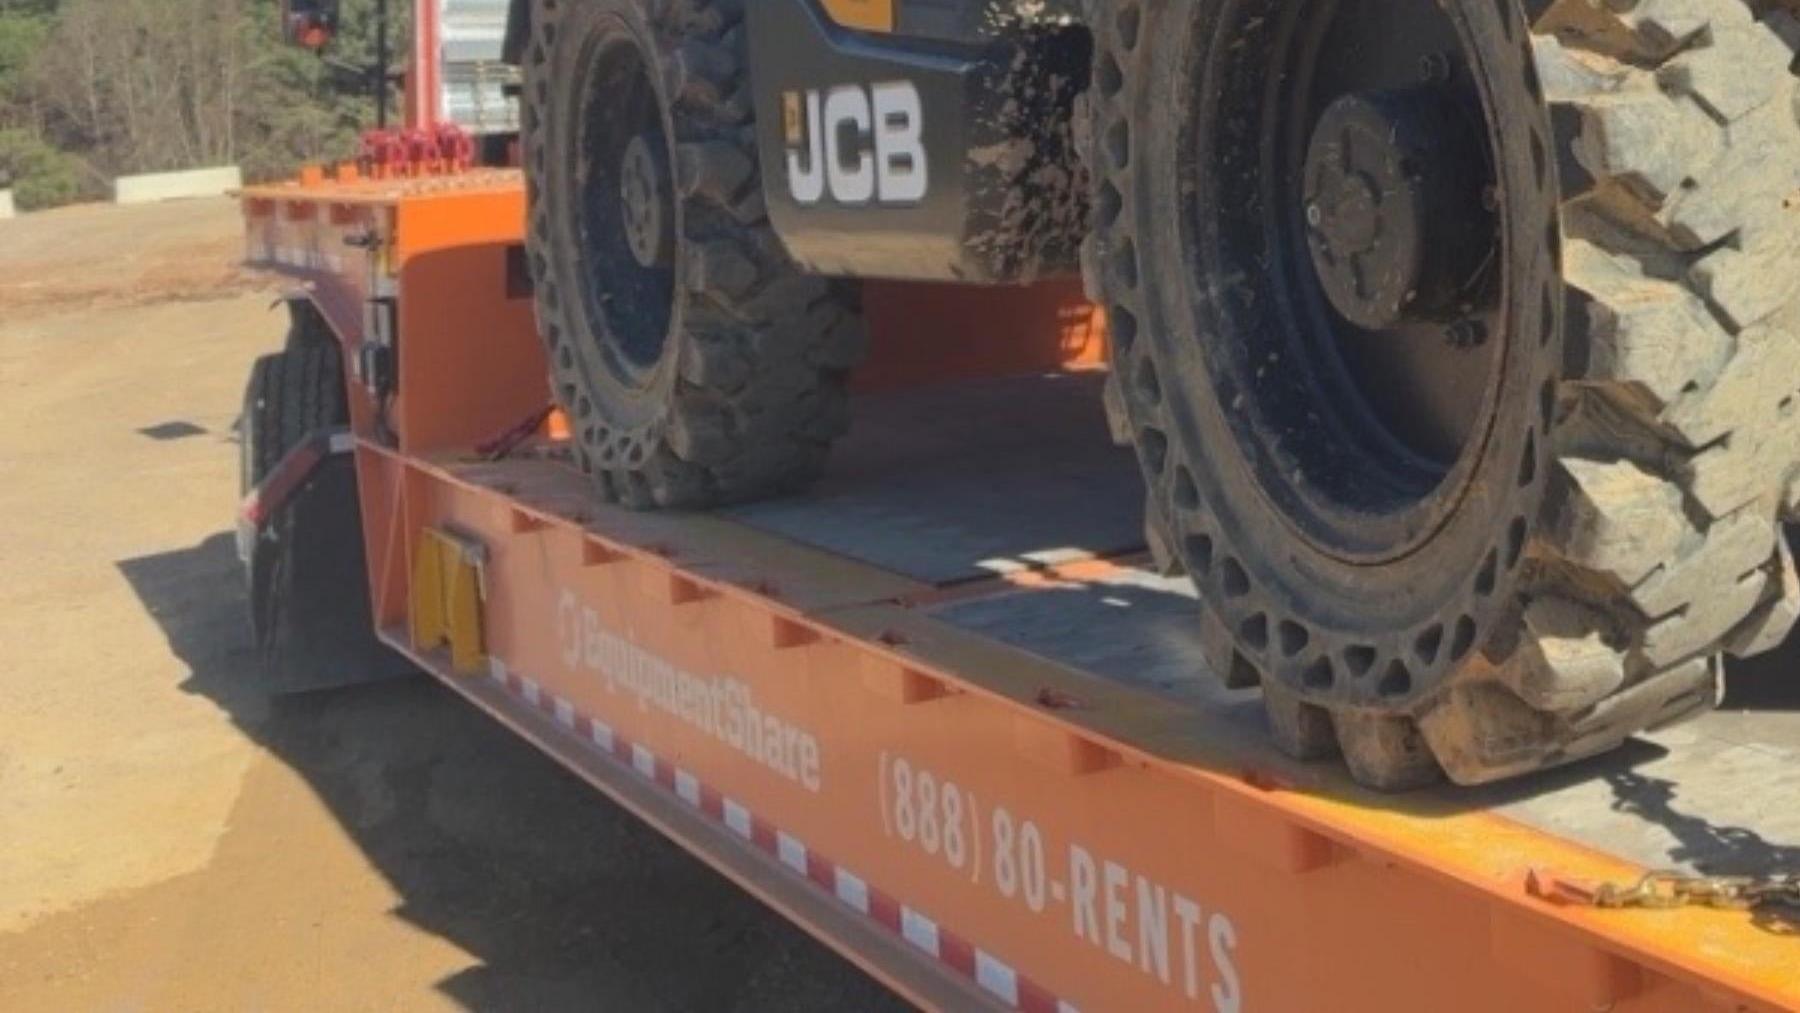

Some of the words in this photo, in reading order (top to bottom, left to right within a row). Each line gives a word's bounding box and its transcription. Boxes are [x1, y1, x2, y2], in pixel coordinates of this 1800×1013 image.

[778, 80, 928, 202] JCB
[581, 604, 821, 793] EquipmentShare
[879, 751, 981, 884] (888)
[993, 807, 1242, 1013] 80-RENTS
